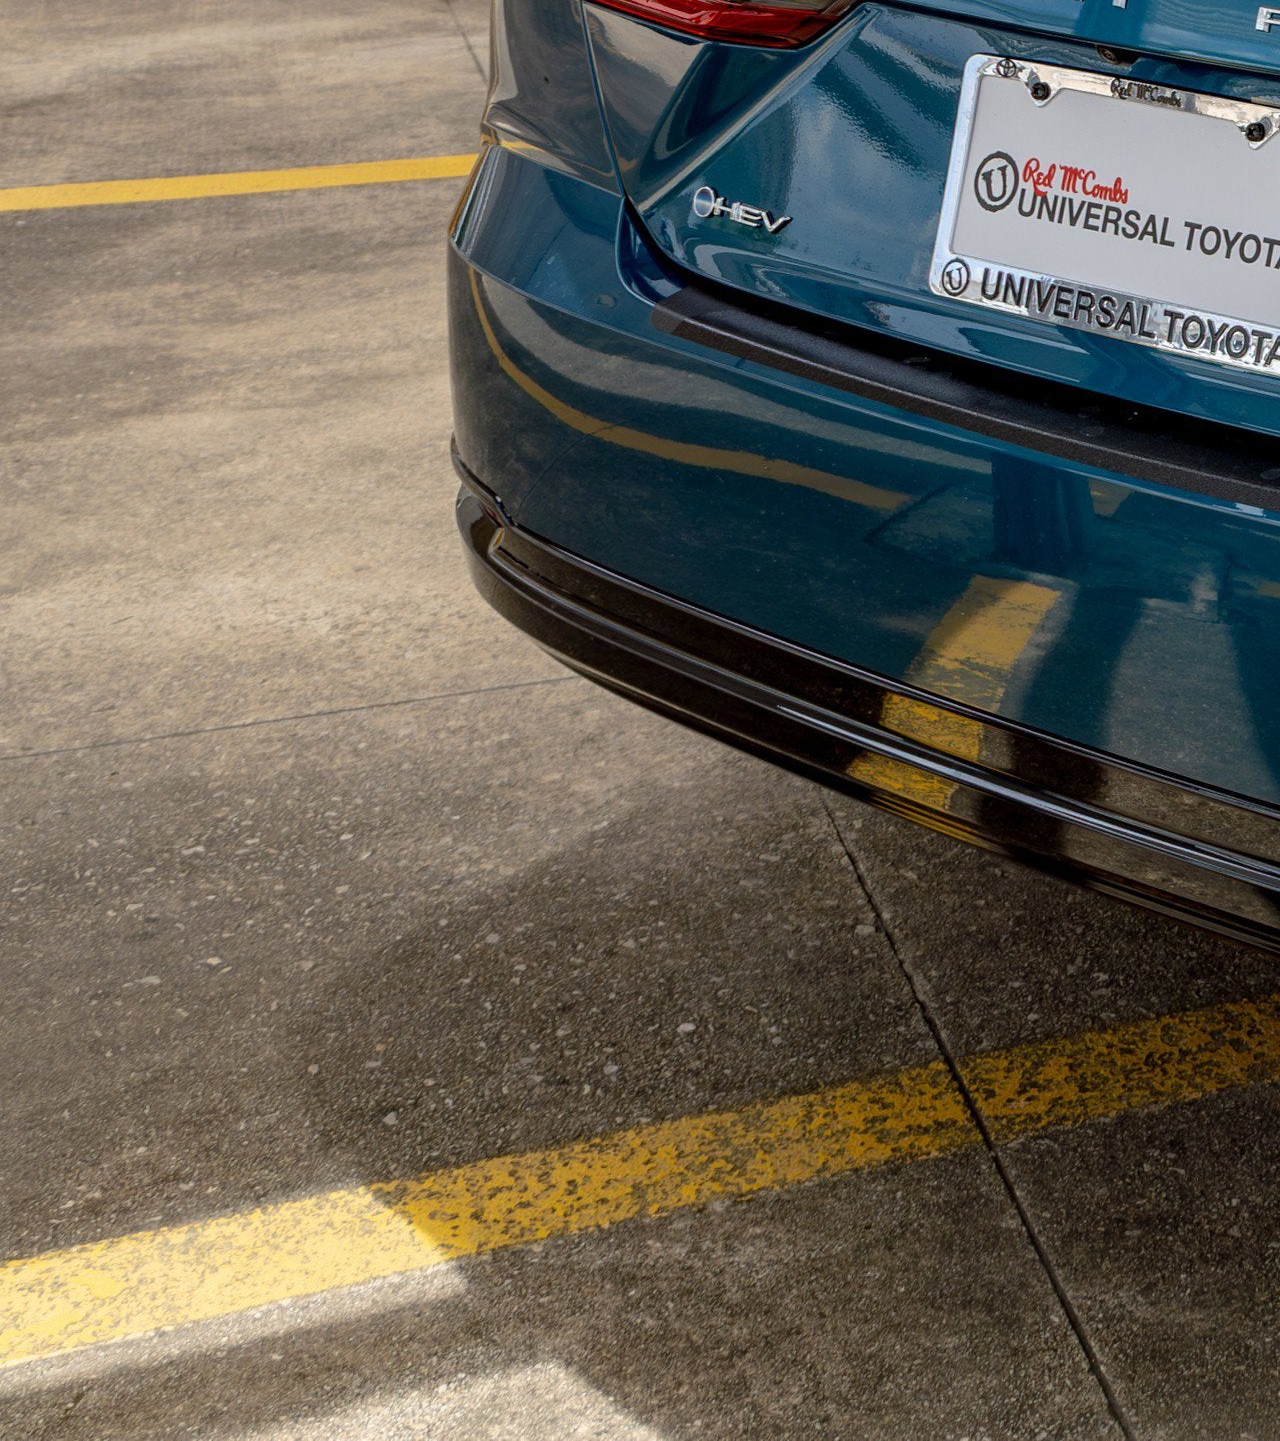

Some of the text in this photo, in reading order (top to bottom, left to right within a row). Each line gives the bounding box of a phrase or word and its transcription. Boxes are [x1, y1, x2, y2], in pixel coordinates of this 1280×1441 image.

[1022, 158, 1129, 204] Red McCombs
[1017, 188, 1175, 247] UNIVERSAL
[981, 267, 1158, 339] UNIVERSAL
